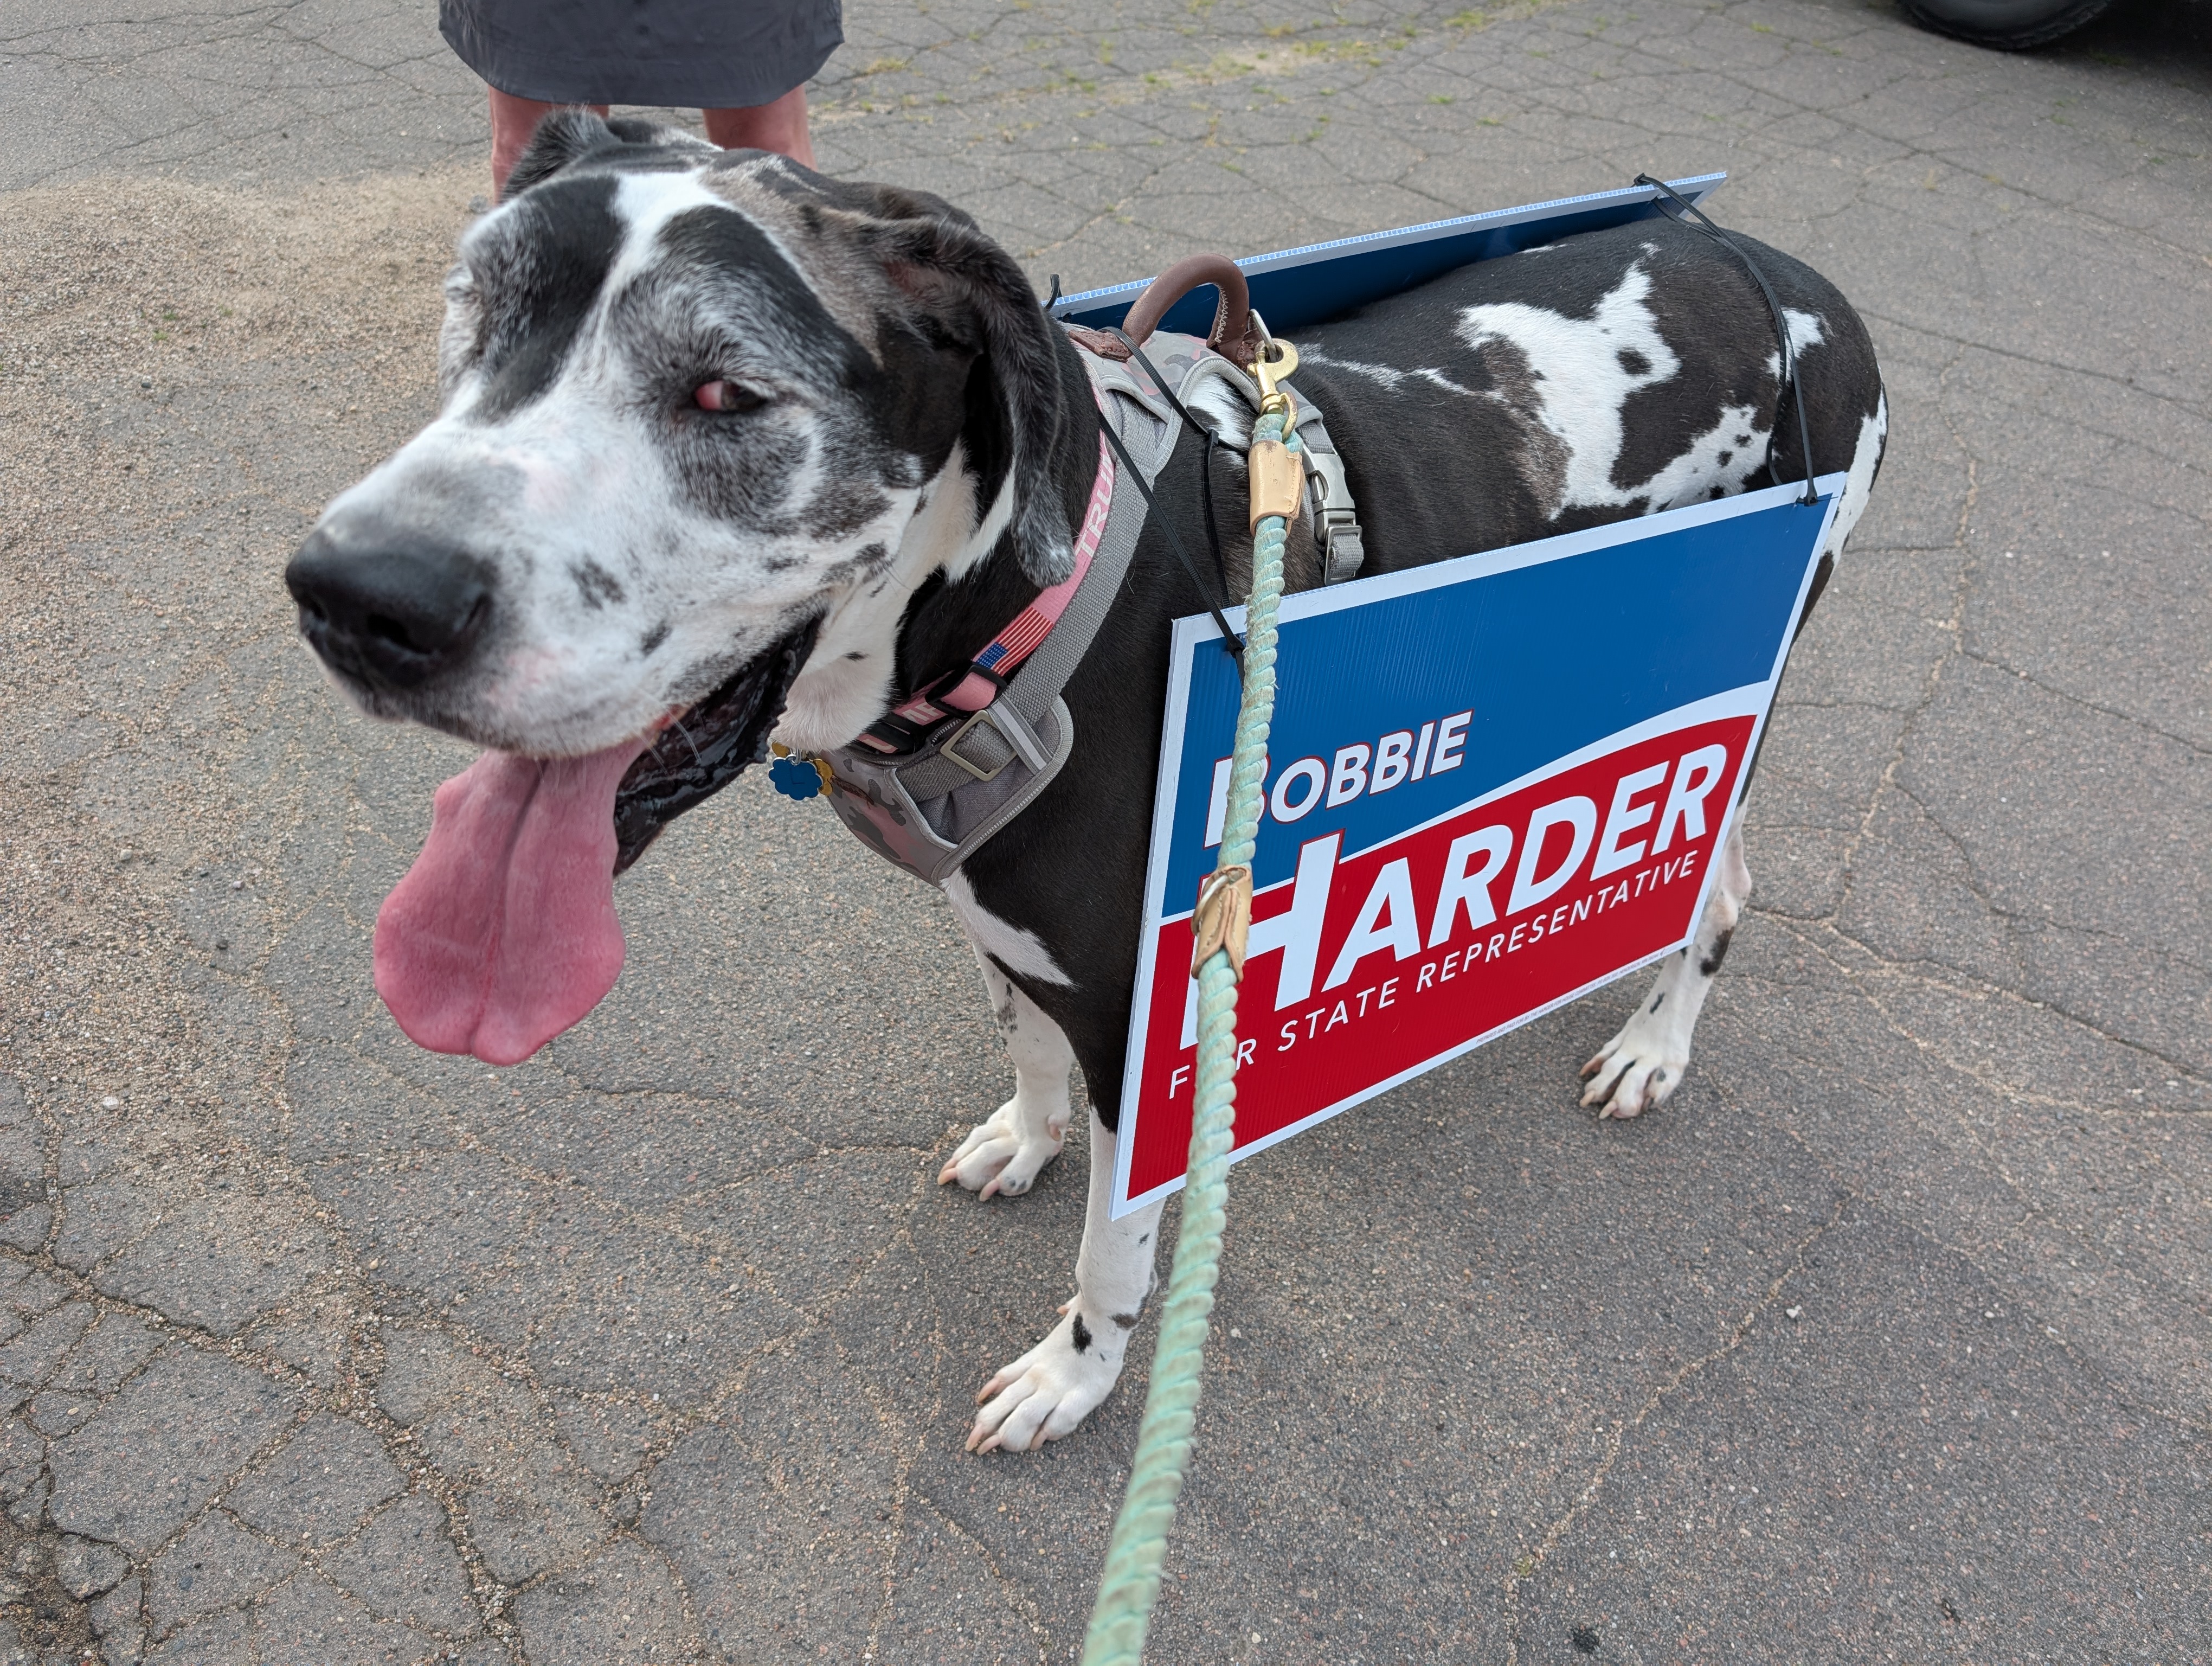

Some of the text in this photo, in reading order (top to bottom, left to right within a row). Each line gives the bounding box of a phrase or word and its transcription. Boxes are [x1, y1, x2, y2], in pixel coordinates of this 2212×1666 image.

[1075, 454, 1114, 559] TRU
[1169, 849, 1698, 1099] FR STATE REPRESENTATIVE
[1180, 743, 1727, 1050] HARDER
[1497, 1026, 1506, 1034] AND
